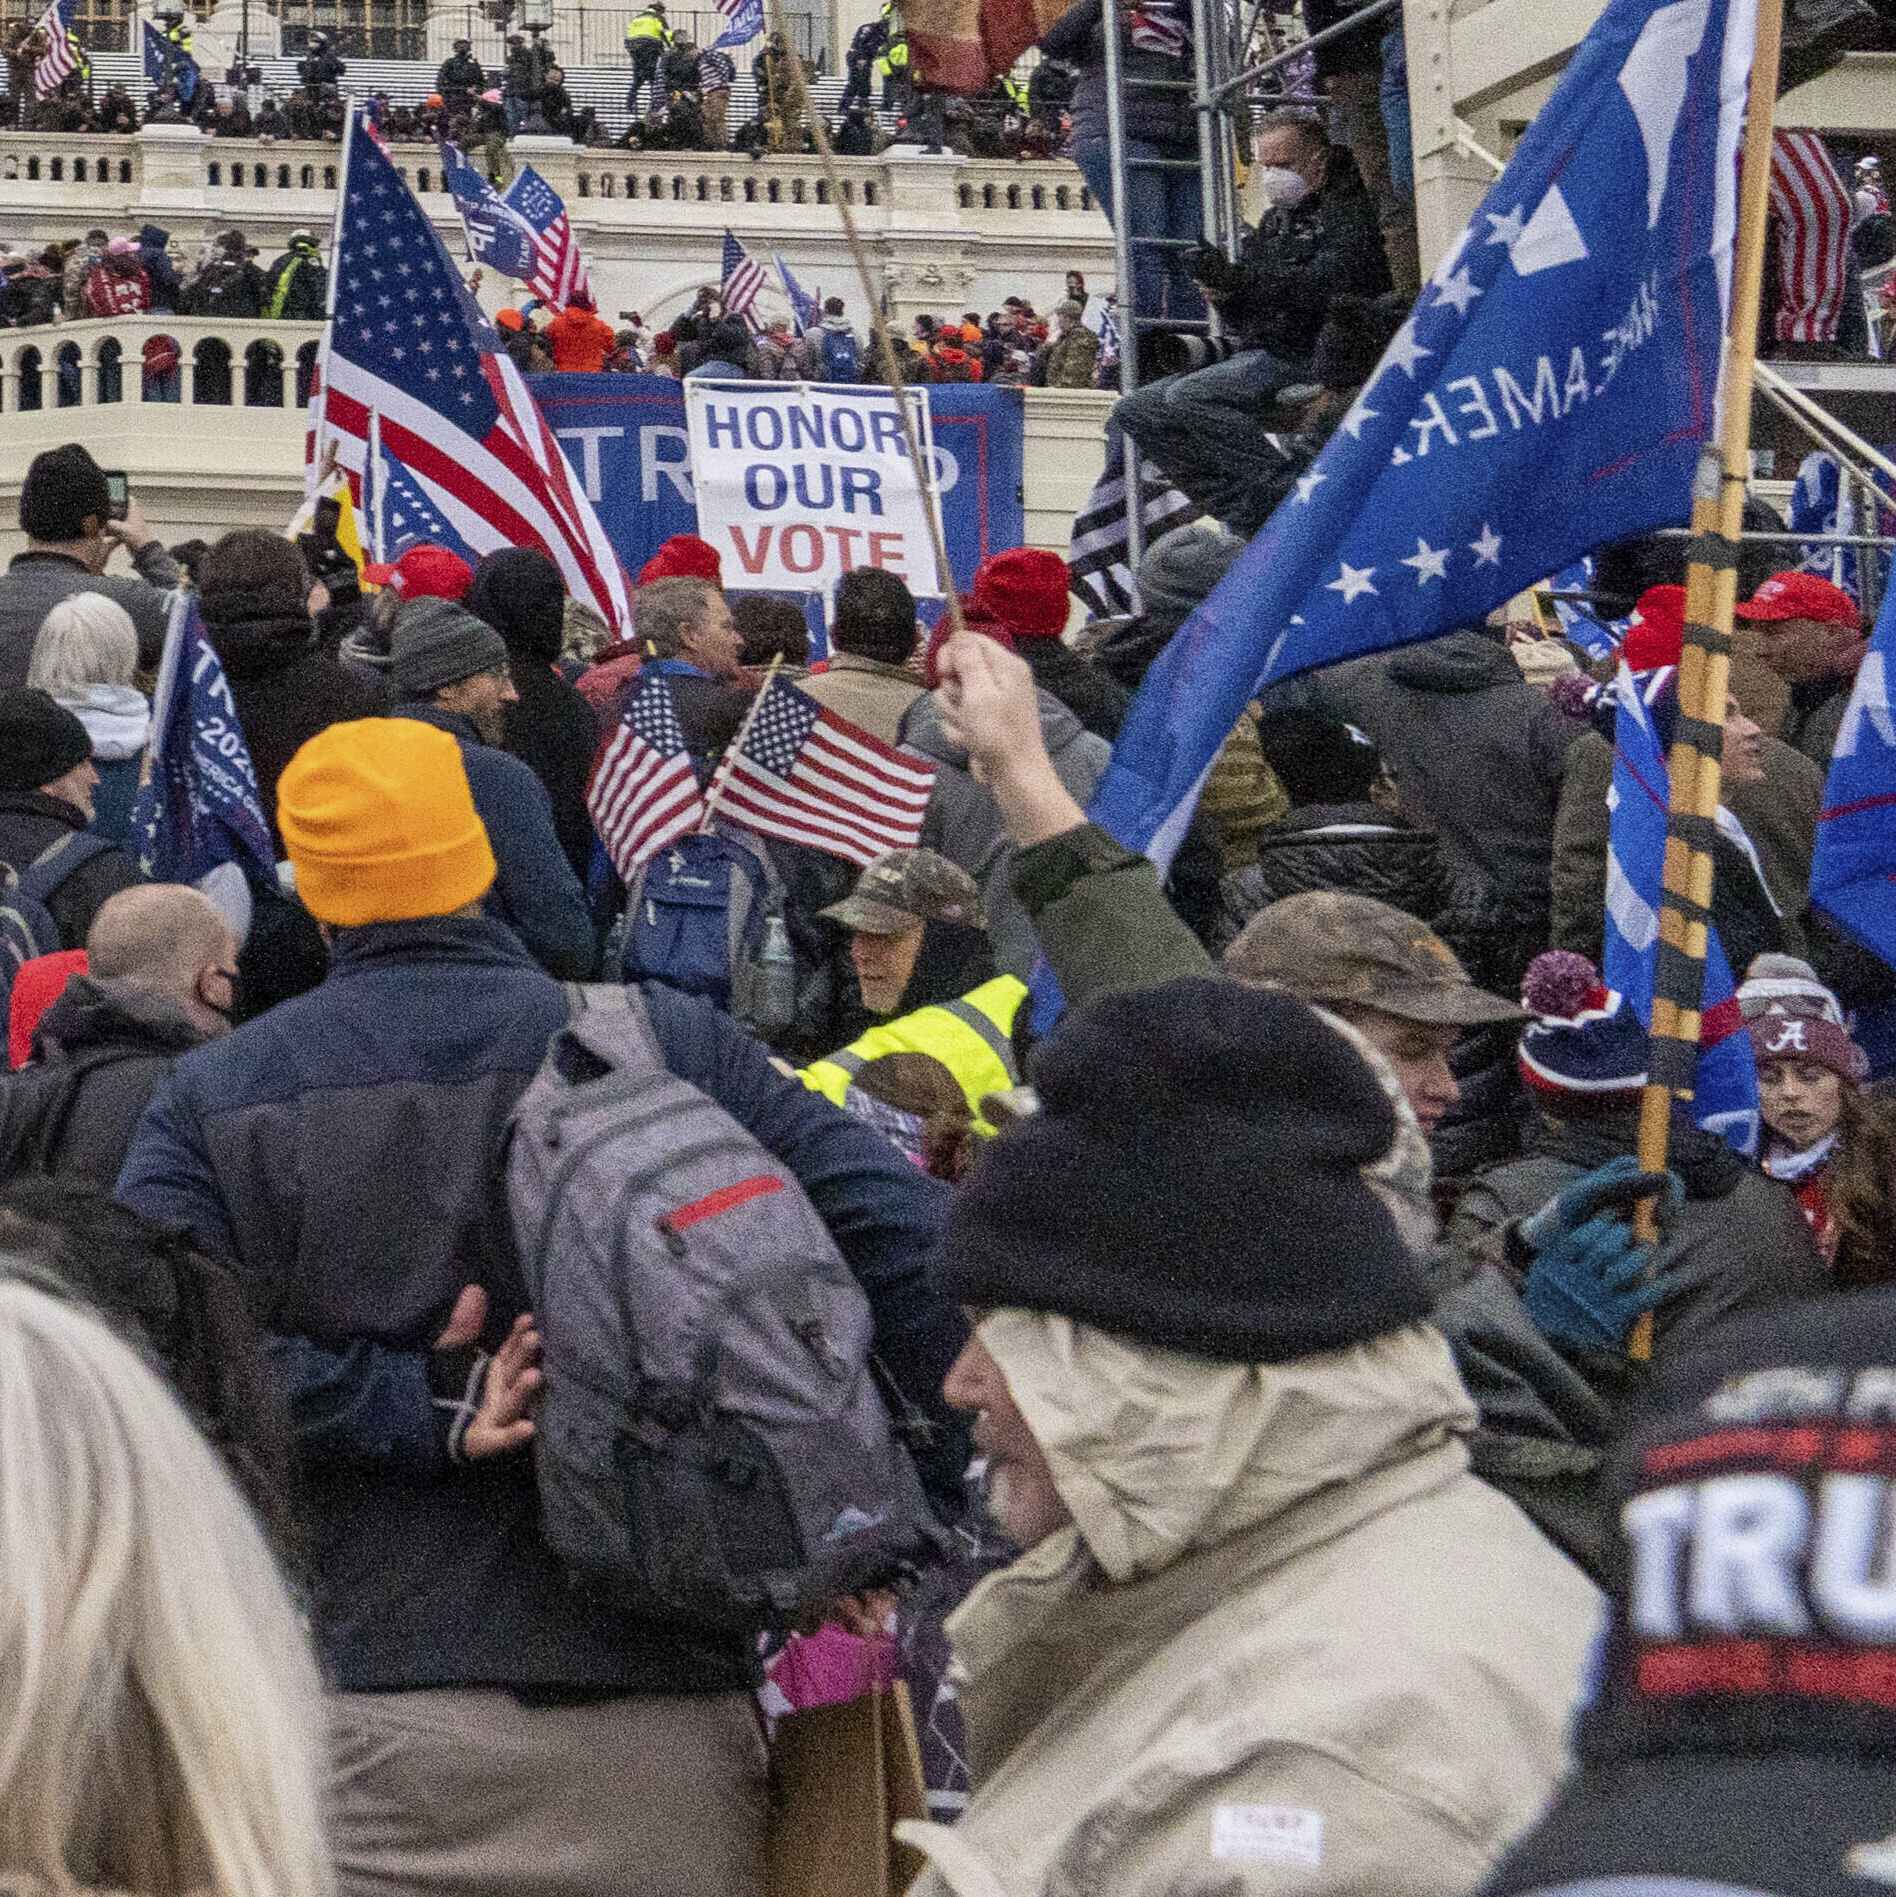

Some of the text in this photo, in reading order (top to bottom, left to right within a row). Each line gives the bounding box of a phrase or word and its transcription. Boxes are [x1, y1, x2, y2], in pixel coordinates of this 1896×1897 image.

[706, 404, 907, 457] HONOR
[555, 425, 959, 504] TRP
[745, 464, 884, 516] OUR
[728, 523, 905, 580] VOTE
[1621, 1471, 1896, 1644] TRU
